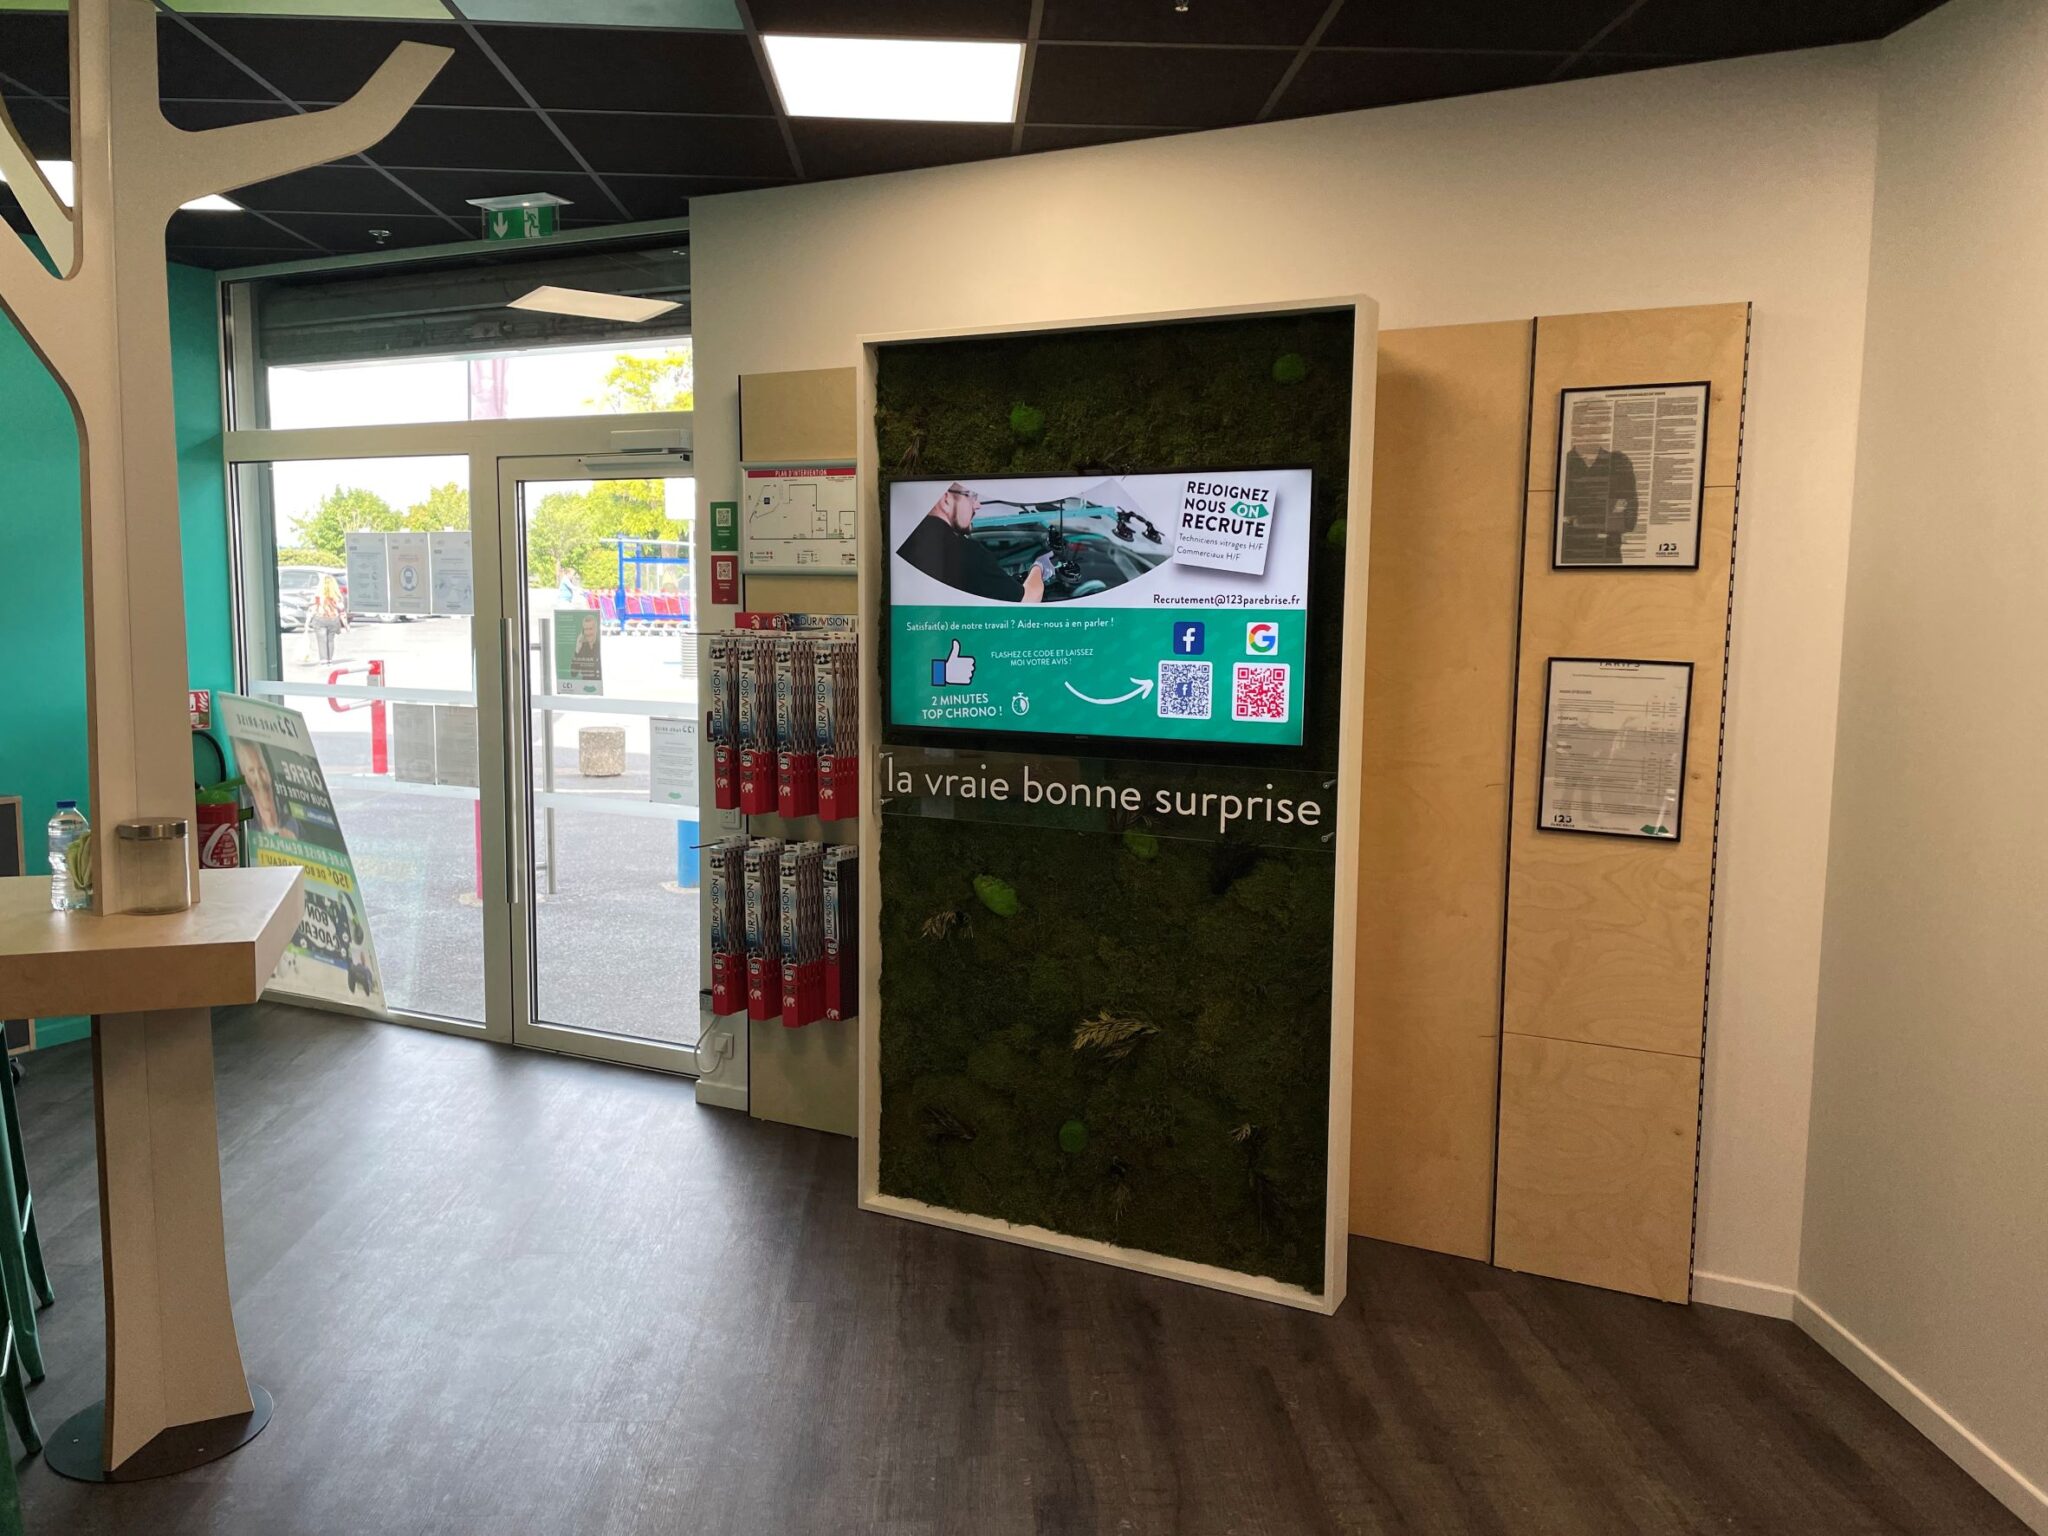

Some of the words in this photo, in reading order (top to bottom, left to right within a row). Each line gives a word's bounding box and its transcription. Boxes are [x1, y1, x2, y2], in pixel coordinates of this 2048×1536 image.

[1187, 481, 1269, 502] REJOIGNEZ
[1184, 498, 1226, 513] NOUS
[1236, 504, 1260, 518] ON
[1182, 513, 1266, 538] RECRUTE
[1179, 533, 1218, 546] Techniciens
[1219, 539, 1247, 551] vitrages
[1249, 542, 1264, 551] H/F
[1659, 543, 1677, 551] 123
[1176, 546, 1224, 559] Commerciaux
[1226, 552, 1241, 561] H/F
[1153, 594, 1300, 608] Recrutement@123parebrise.fr
[906, 621, 948, 632] Satisfait(e)
[950, 621, 960, 630] de
[961, 622, 983, 630] notre
[984, 620, 1009, 630] travail
[1010, 619, 1015, 629] ?
[1017, 619, 1063, 629] Aidez-nous
[1065, 618, 1070, 628] à
[1071, 620, 1082, 628] en
[1084, 618, 1109, 630] parler
[991, 650, 1022, 659] FLASHEZ
[1022, 650, 1032, 658] CE
[1033, 649, 1054, 658] CODE
[1055, 649, 1064, 657] ET
[1065, 648, 1094, 657] LAISSEZ
[1010, 658, 1025, 667] MOI
[1026, 657, 1050, 666] VOTRE
[1051, 657, 1068, 665] AVIS
[931, 696, 937, 706] 2
[939, 693, 989, 706] MINUTES
[922, 709, 943, 720] TOP
[945, 706, 997, 718] CHRONO
[999, 706, 1003, 716] !
[888, 756, 912, 793] la
[924, 764, 1010, 800] vraie
[1023, 765, 1142, 812] bonne
[1155, 783, 1321, 834] surprise
[1554, 815, 1572, 823] 123
